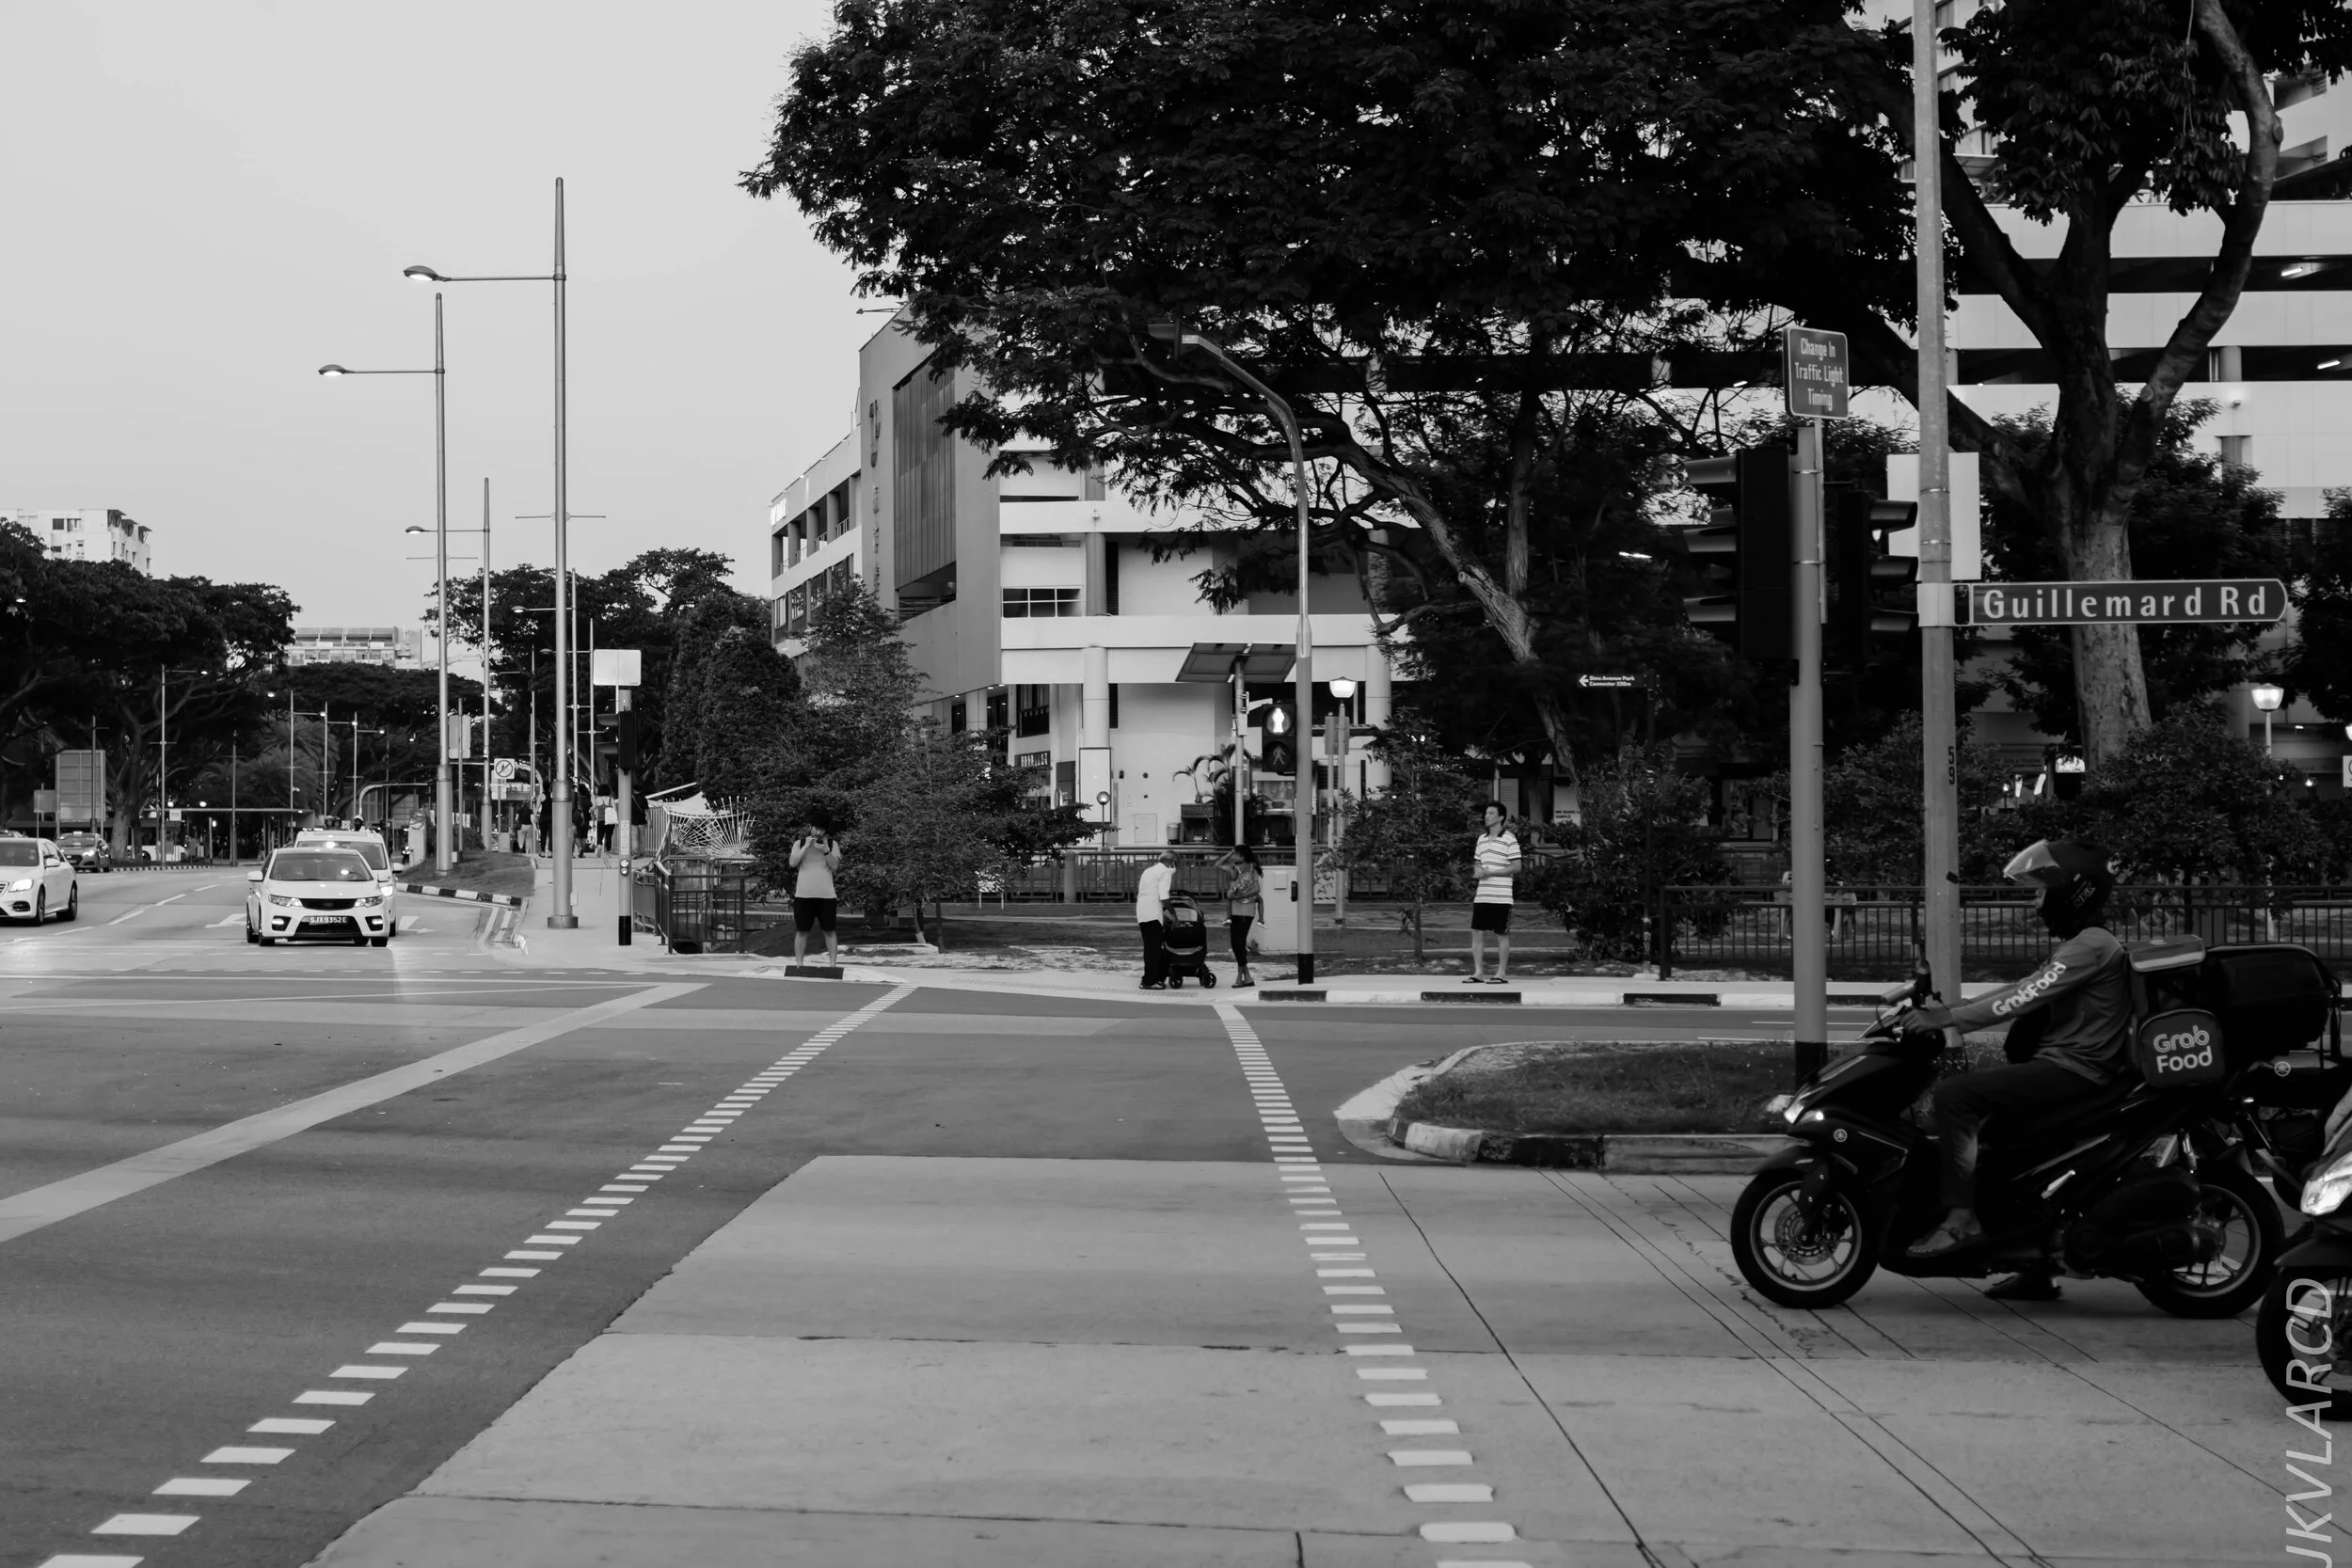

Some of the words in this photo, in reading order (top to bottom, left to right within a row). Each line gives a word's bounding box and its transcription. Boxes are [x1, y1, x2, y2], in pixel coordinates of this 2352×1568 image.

[1800, 338, 1828, 362] Change
[1828, 341, 1836, 358] In
[1794, 361, 1822, 381] Traffic
[1823, 365, 1844, 388] Light
[1807, 387, 1834, 412] Timing
[1982, 587, 2201, 619] Guillemard
[2220, 586, 2266, 616] Rd
[2153, 1024, 2211, 1053] Grab
[2156, 1045, 2213, 1074] Food
